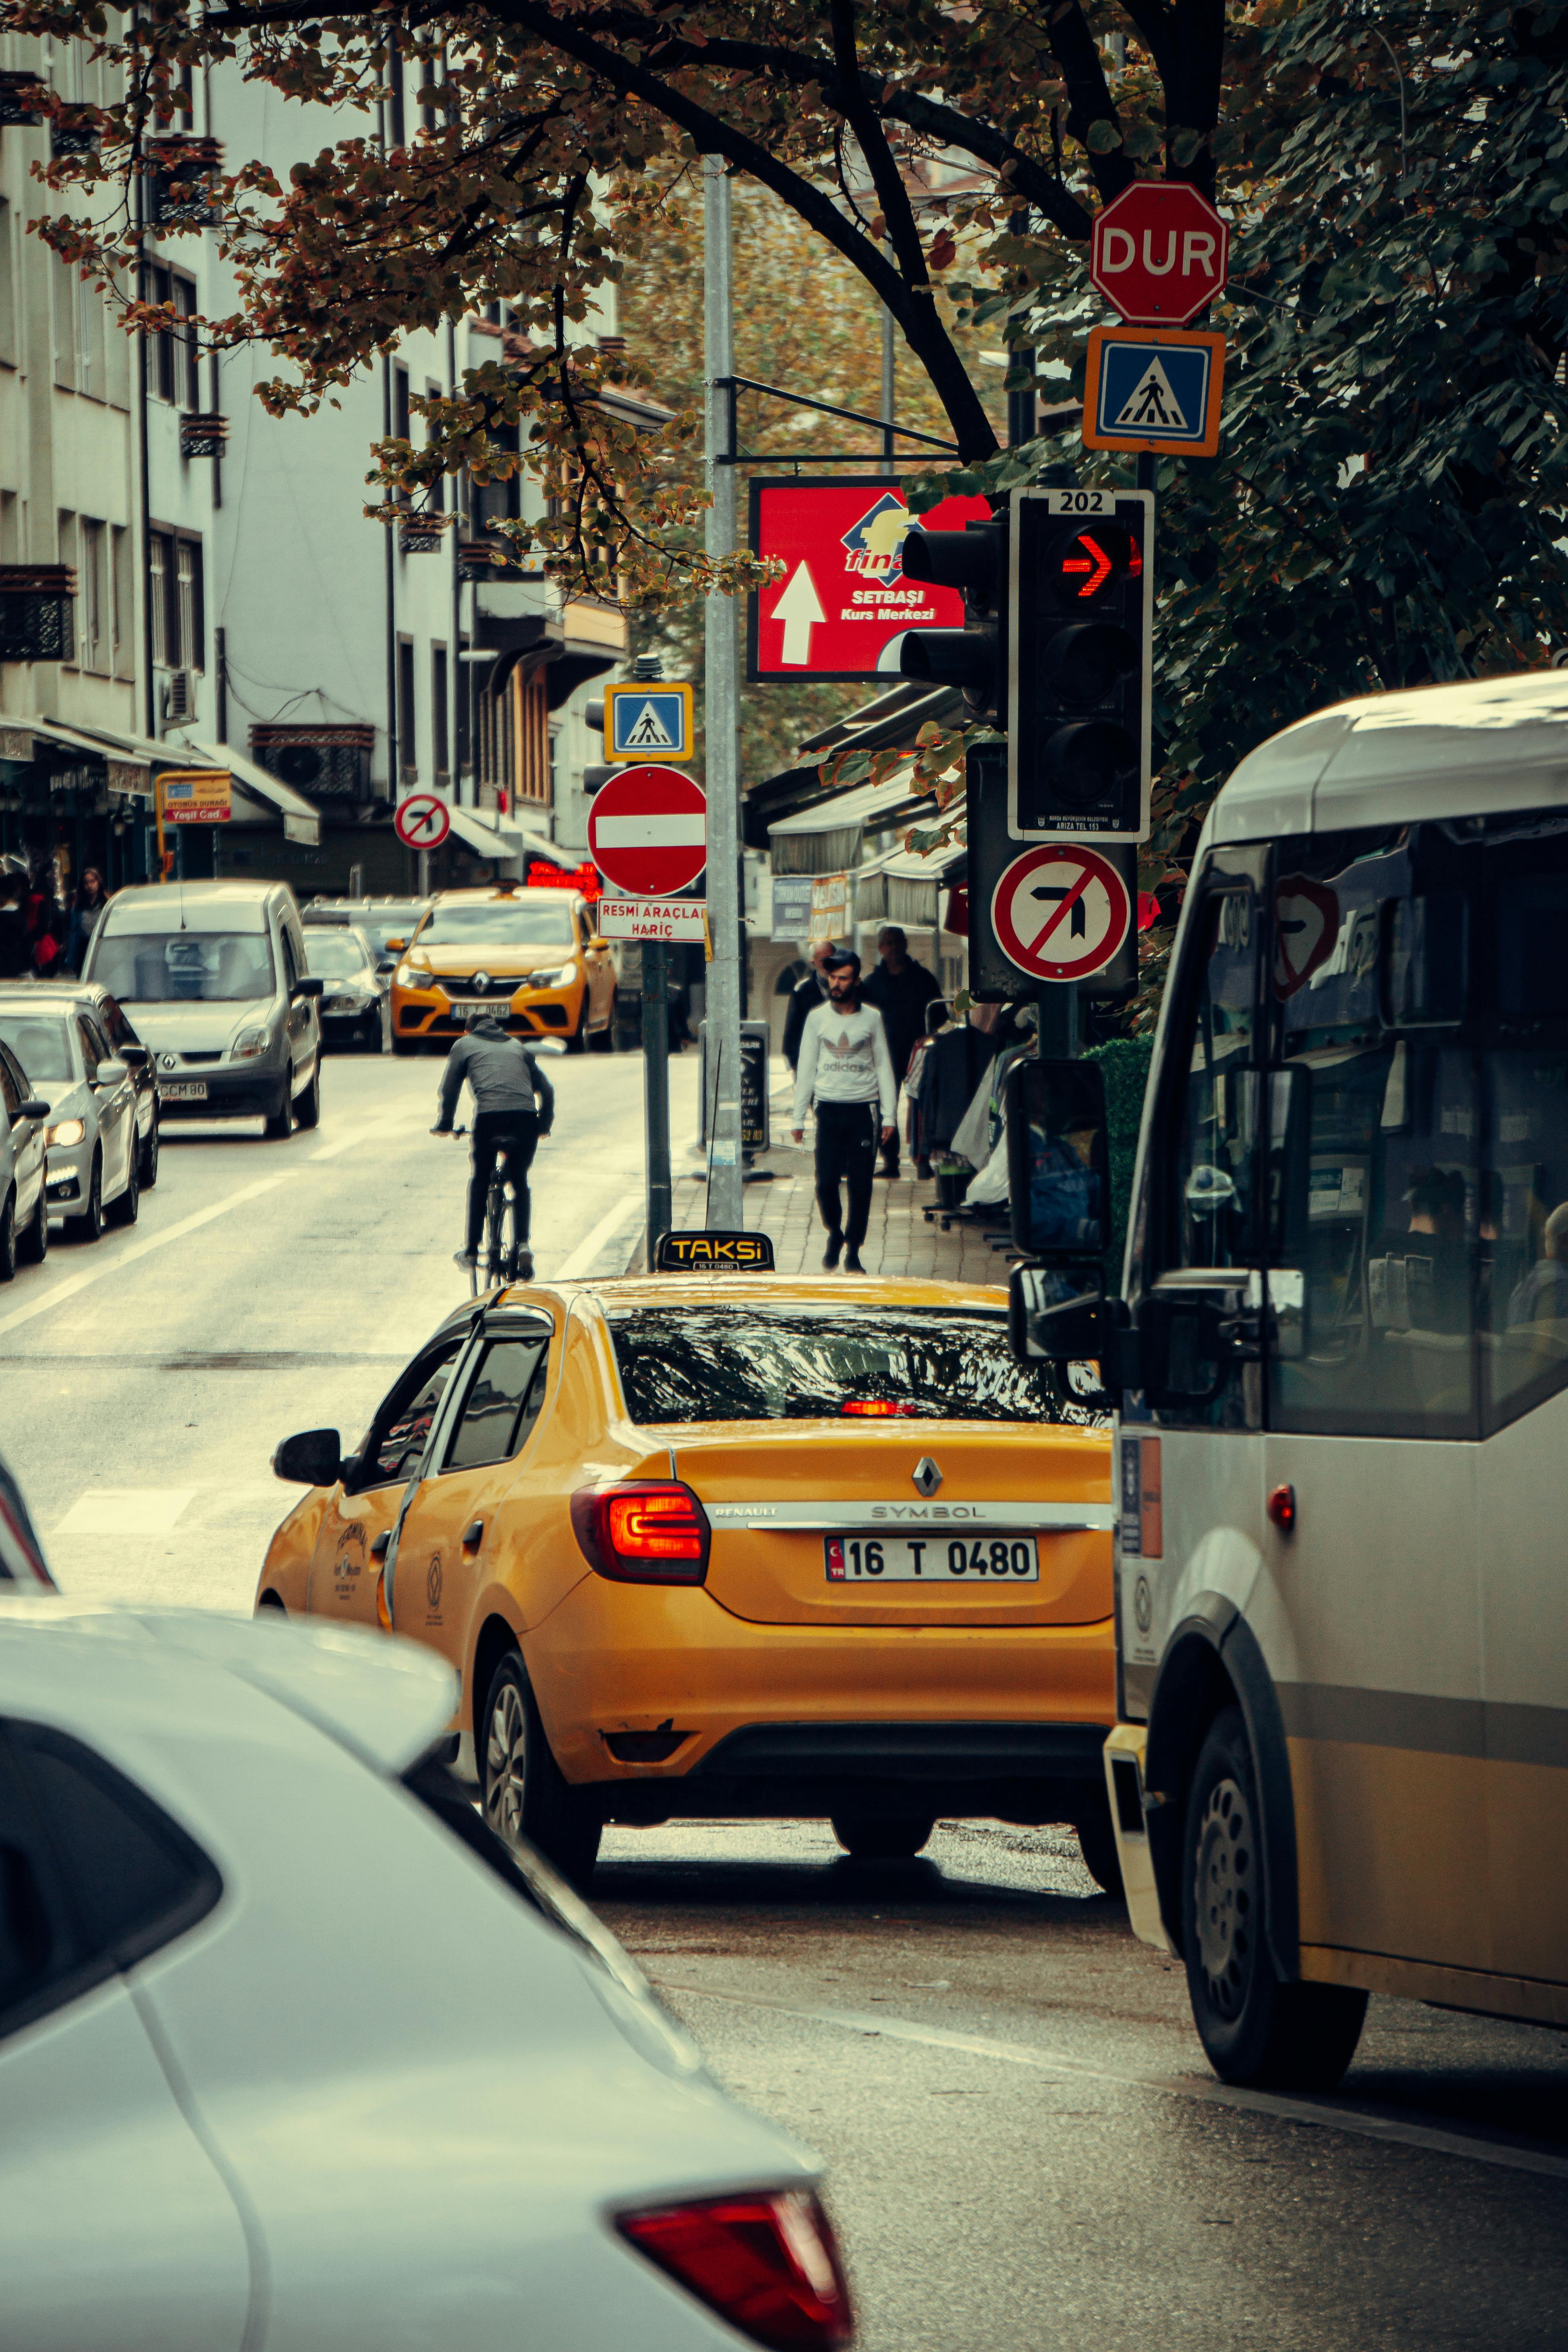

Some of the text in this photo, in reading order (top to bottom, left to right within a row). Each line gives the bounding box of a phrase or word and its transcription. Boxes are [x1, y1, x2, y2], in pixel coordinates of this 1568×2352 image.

[1102, 228, 1216, 277] DUR
[1060, 492, 1103, 512] 202
[851, 590, 924, 607] SETBAŞI
[841, 608, 935, 621] Kurs Merkezi
[173, 809, 222, 822] Yeşil Cad.
[603, 903, 705, 920] RESMİ ARAÇLA
[632, 922, 673, 937] HARİÇ
[824, 1062, 865, 1072] adidas
[190, 1084, 204, 1095] 80
[715, 1506, 986, 1519] RENAULT SYMBOL
[849, 1541, 1030, 1575] 16 T 0480
[832, 1568, 844, 1576] TR
